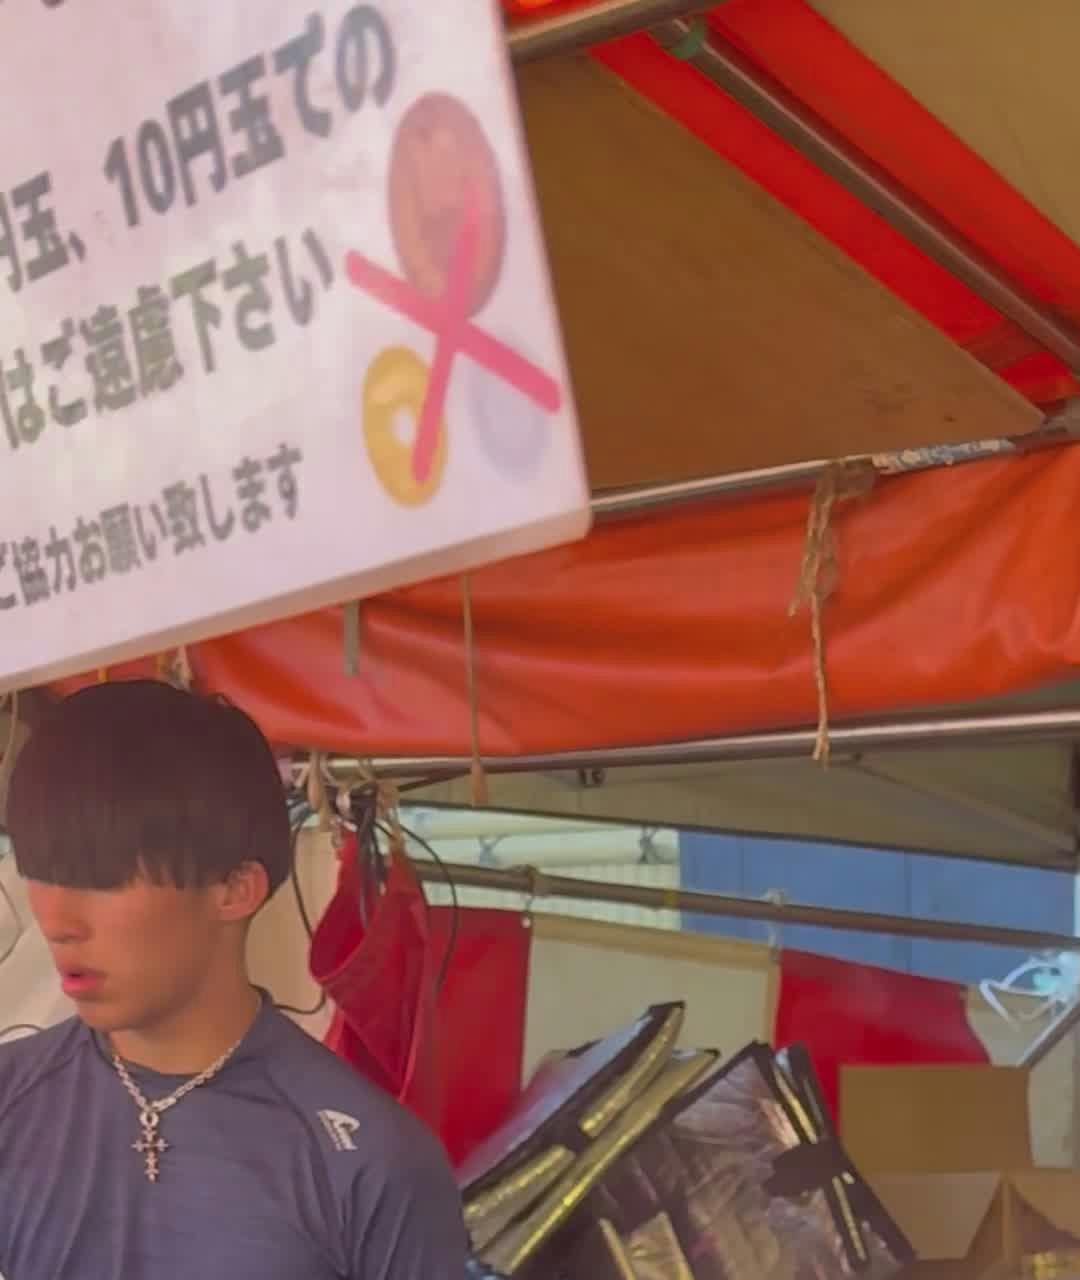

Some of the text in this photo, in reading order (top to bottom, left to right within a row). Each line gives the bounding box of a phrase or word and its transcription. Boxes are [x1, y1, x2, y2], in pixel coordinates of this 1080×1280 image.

[0, 227, 334, 450] はご遠慮下さい
